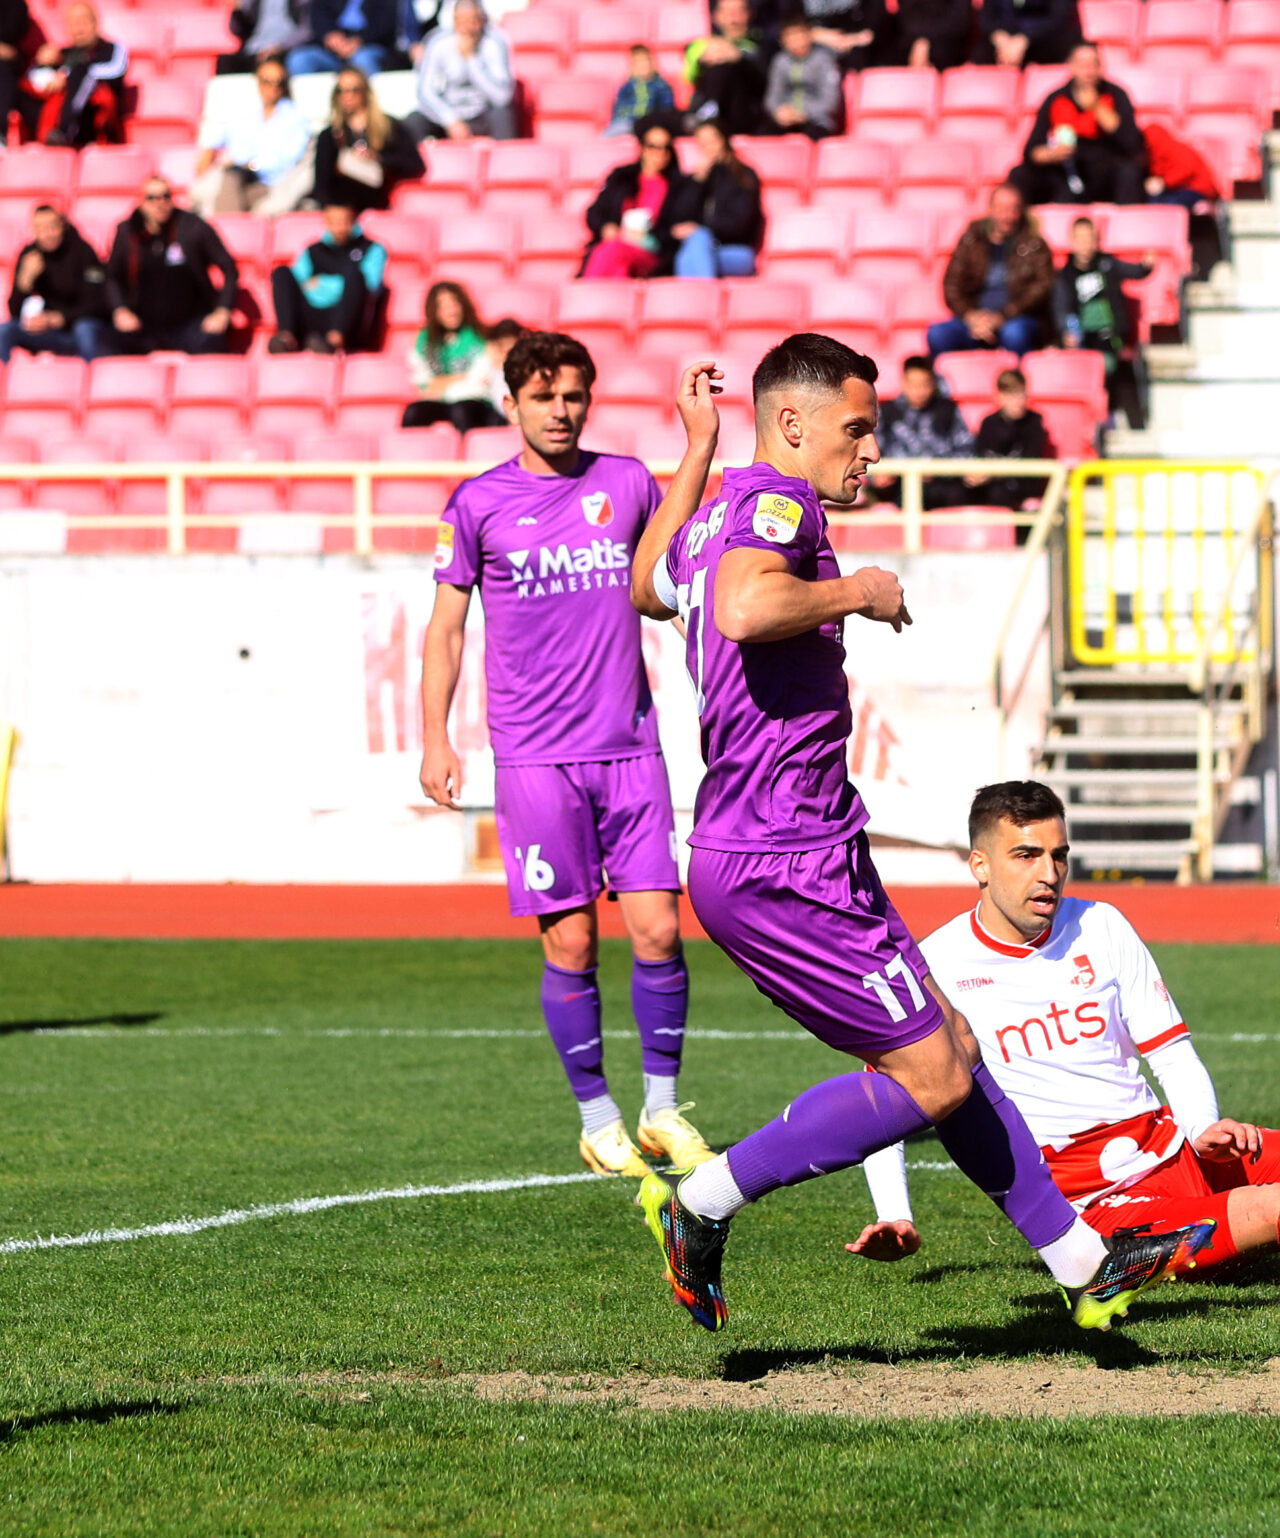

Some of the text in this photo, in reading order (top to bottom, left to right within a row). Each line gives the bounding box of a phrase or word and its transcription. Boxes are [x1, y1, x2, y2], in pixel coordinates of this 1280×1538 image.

[539, 537, 630, 579] Matis
[515, 843, 556, 892] 16
[862, 951, 927, 1023] 17
[956, 976, 995, 993] BELTONA
[994, 1001, 1107, 1064] mts
